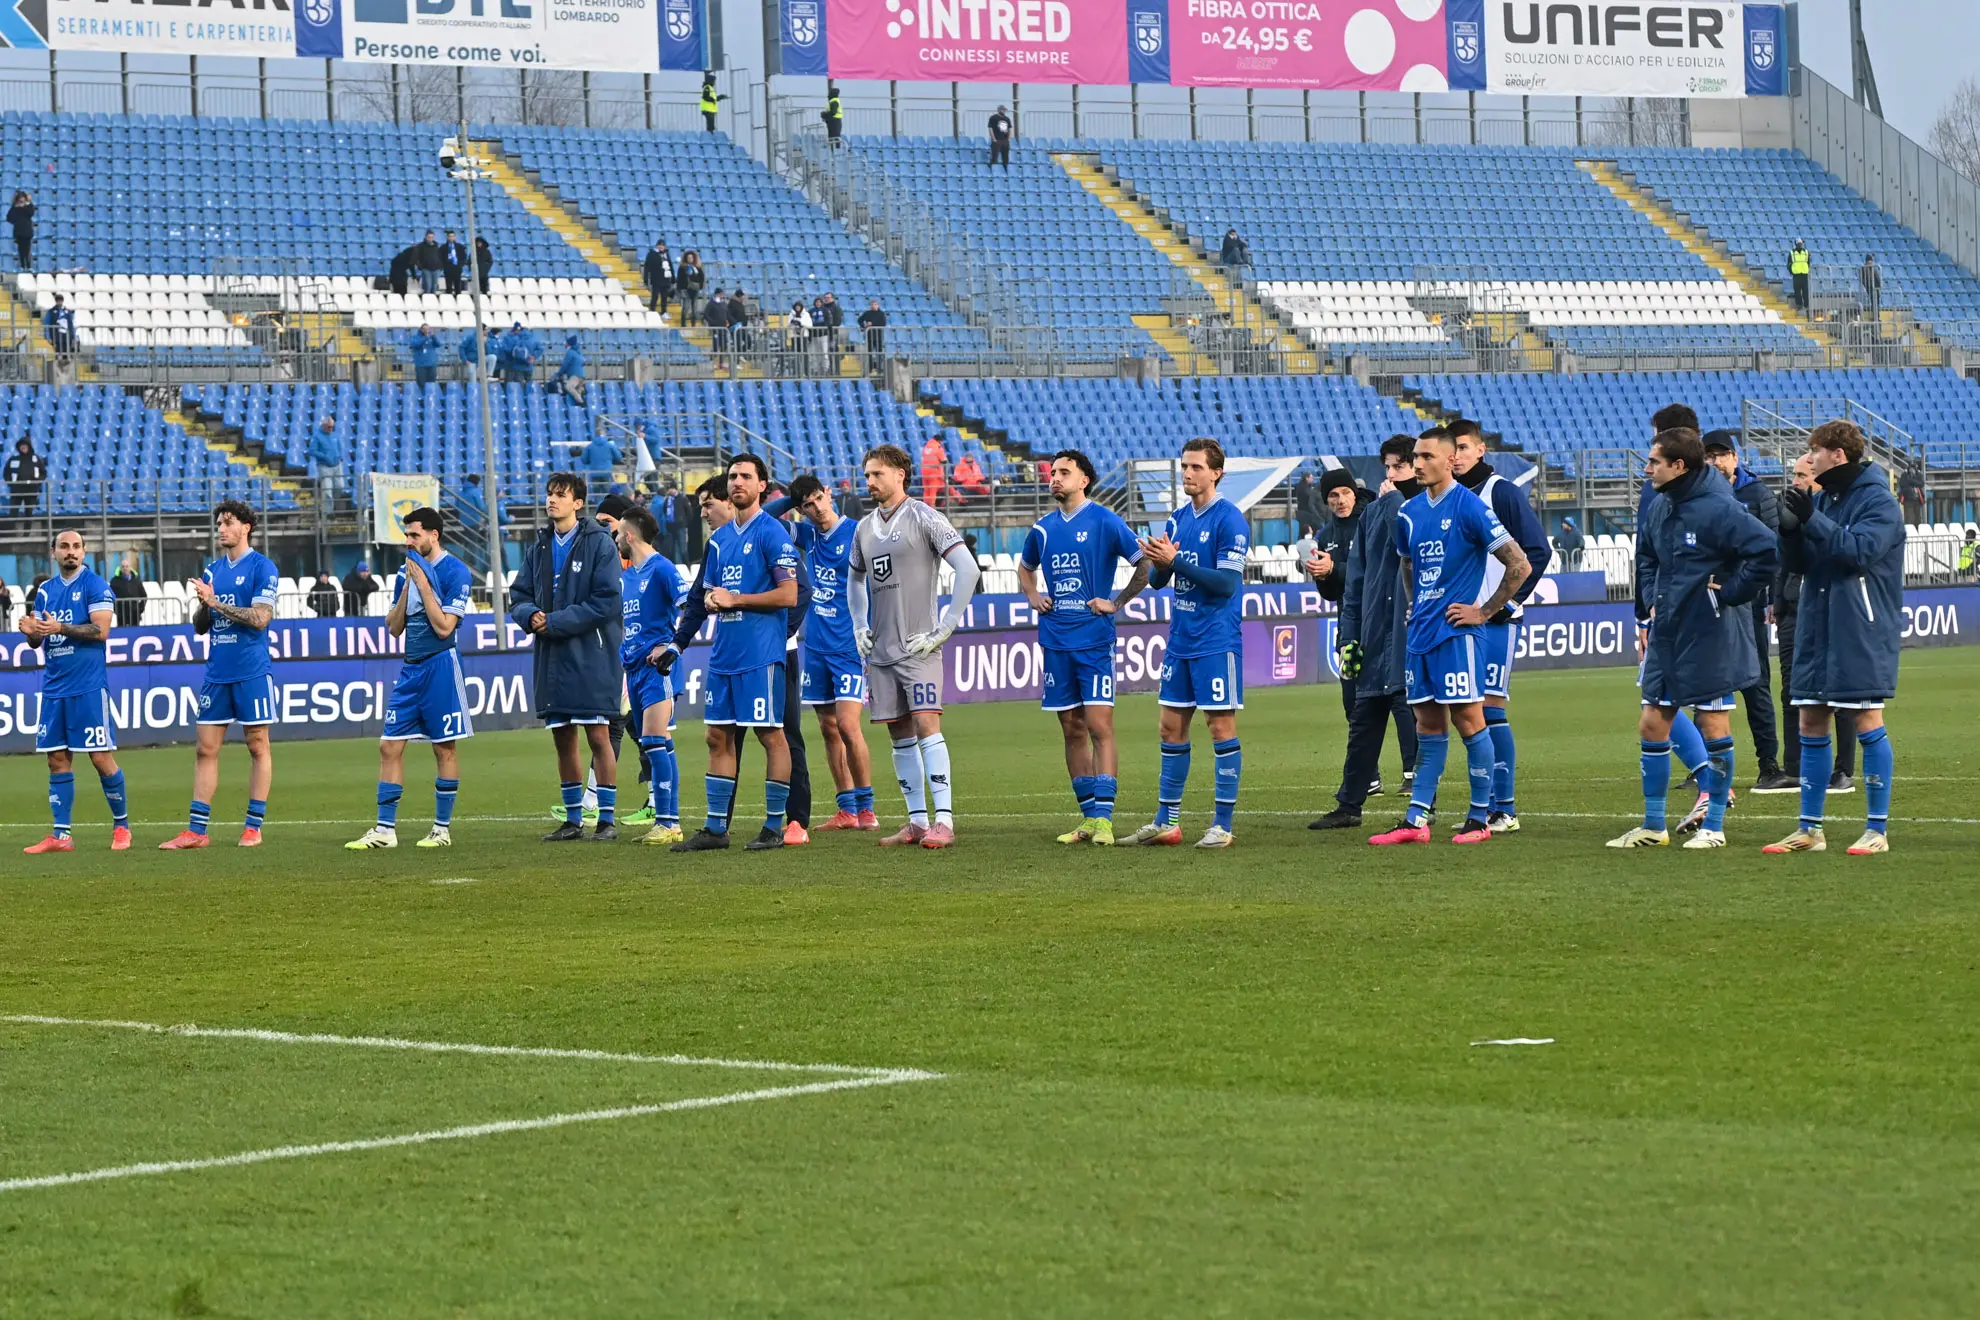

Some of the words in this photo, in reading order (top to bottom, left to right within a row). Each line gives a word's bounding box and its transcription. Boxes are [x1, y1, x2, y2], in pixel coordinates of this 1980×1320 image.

[554, 10, 620, 23] LOMBARDO
[918, 0, 1071, 42] INTRED
[1188, 0, 1247, 19] FIBRA
[1251, 1, 1322, 20] OTTICA
[57, 17, 161, 38] SERRAMENTI
[170, 21, 178, 38] E
[186, 22, 293, 42] CARPENTERIA
[416, 18, 447, 26] CREDITO
[448, 19, 498, 29] COOPERATIVO
[499, 21, 532, 30] ITALIANO
[1503, 3, 1725, 49] UNIFER
[354, 37, 438, 58] Persone
[447, 45, 501, 62] come
[510, 43, 547, 63] voi.
[1201, 32, 1221, 45] DA
[1222, 26, 1289, 55] 24,95
[1293, 29, 1313, 52] €
[919, 48, 1001, 62] CONNESSI
[1006, 50, 1070, 64] SEMPRE
[1505, 52, 1570, 65] SOLUZIONI
[1639, 56, 1663, 67] PER
[1051, 552, 1081, 569] a2a
[721, 565, 743, 581] a2a
[814, 564, 837, 581] a2a
[1055, 582, 1077, 593] DAC
[623, 598, 641, 614] a2a
[1515, 620, 1623, 658] SEGUICI
[839, 673, 862, 696] 37
[1092, 674, 1113, 699] 18
[1444, 671, 1471, 697] 99
[1485, 663, 1505, 689] 31
[912, 682, 937, 706] 66
[1211, 677, 1226, 702] 9
[254, 697, 269, 720] 11
[753, 697, 767, 721] 8
[442, 711, 462, 736] 27
[84, 725, 106, 748] 28
